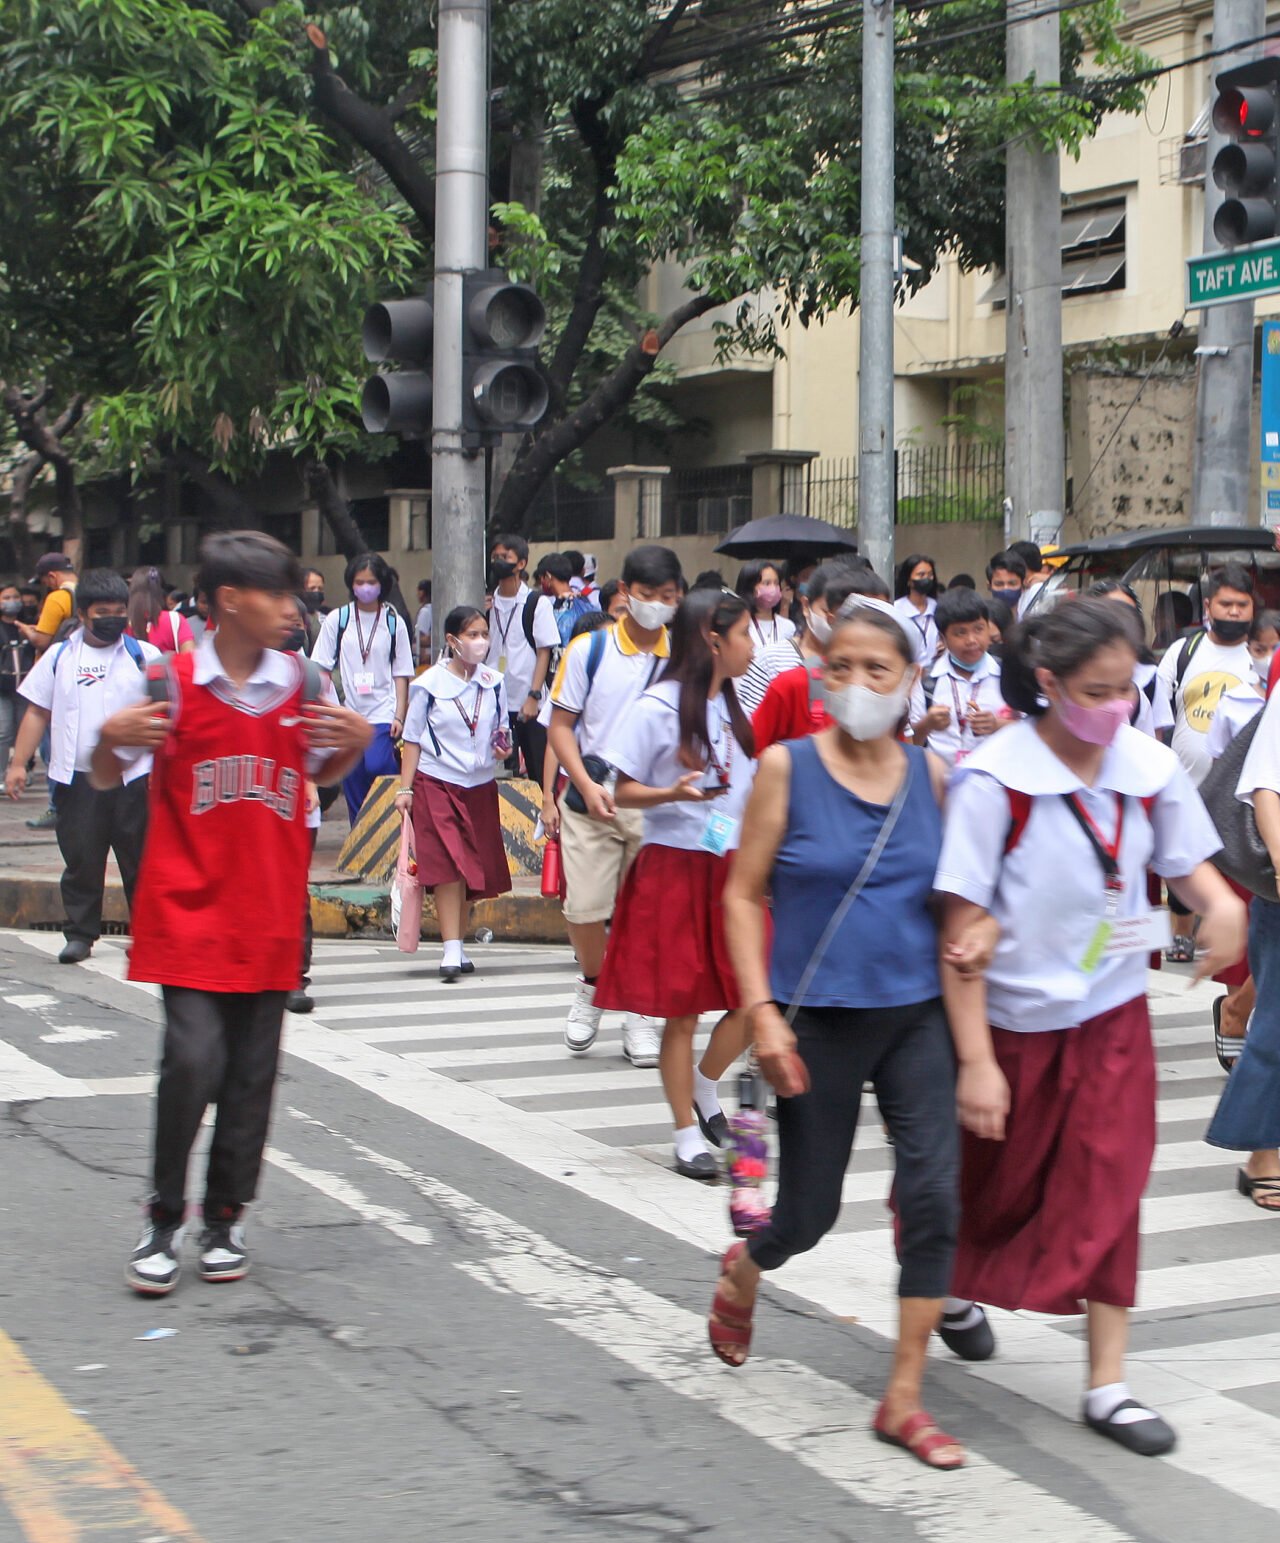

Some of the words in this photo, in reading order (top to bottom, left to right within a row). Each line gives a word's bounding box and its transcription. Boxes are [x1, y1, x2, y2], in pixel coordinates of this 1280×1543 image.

[1196, 264, 1236, 293] TAFT
[1240, 256, 1278, 285] AVE.
[189, 754, 300, 821] BULLS
